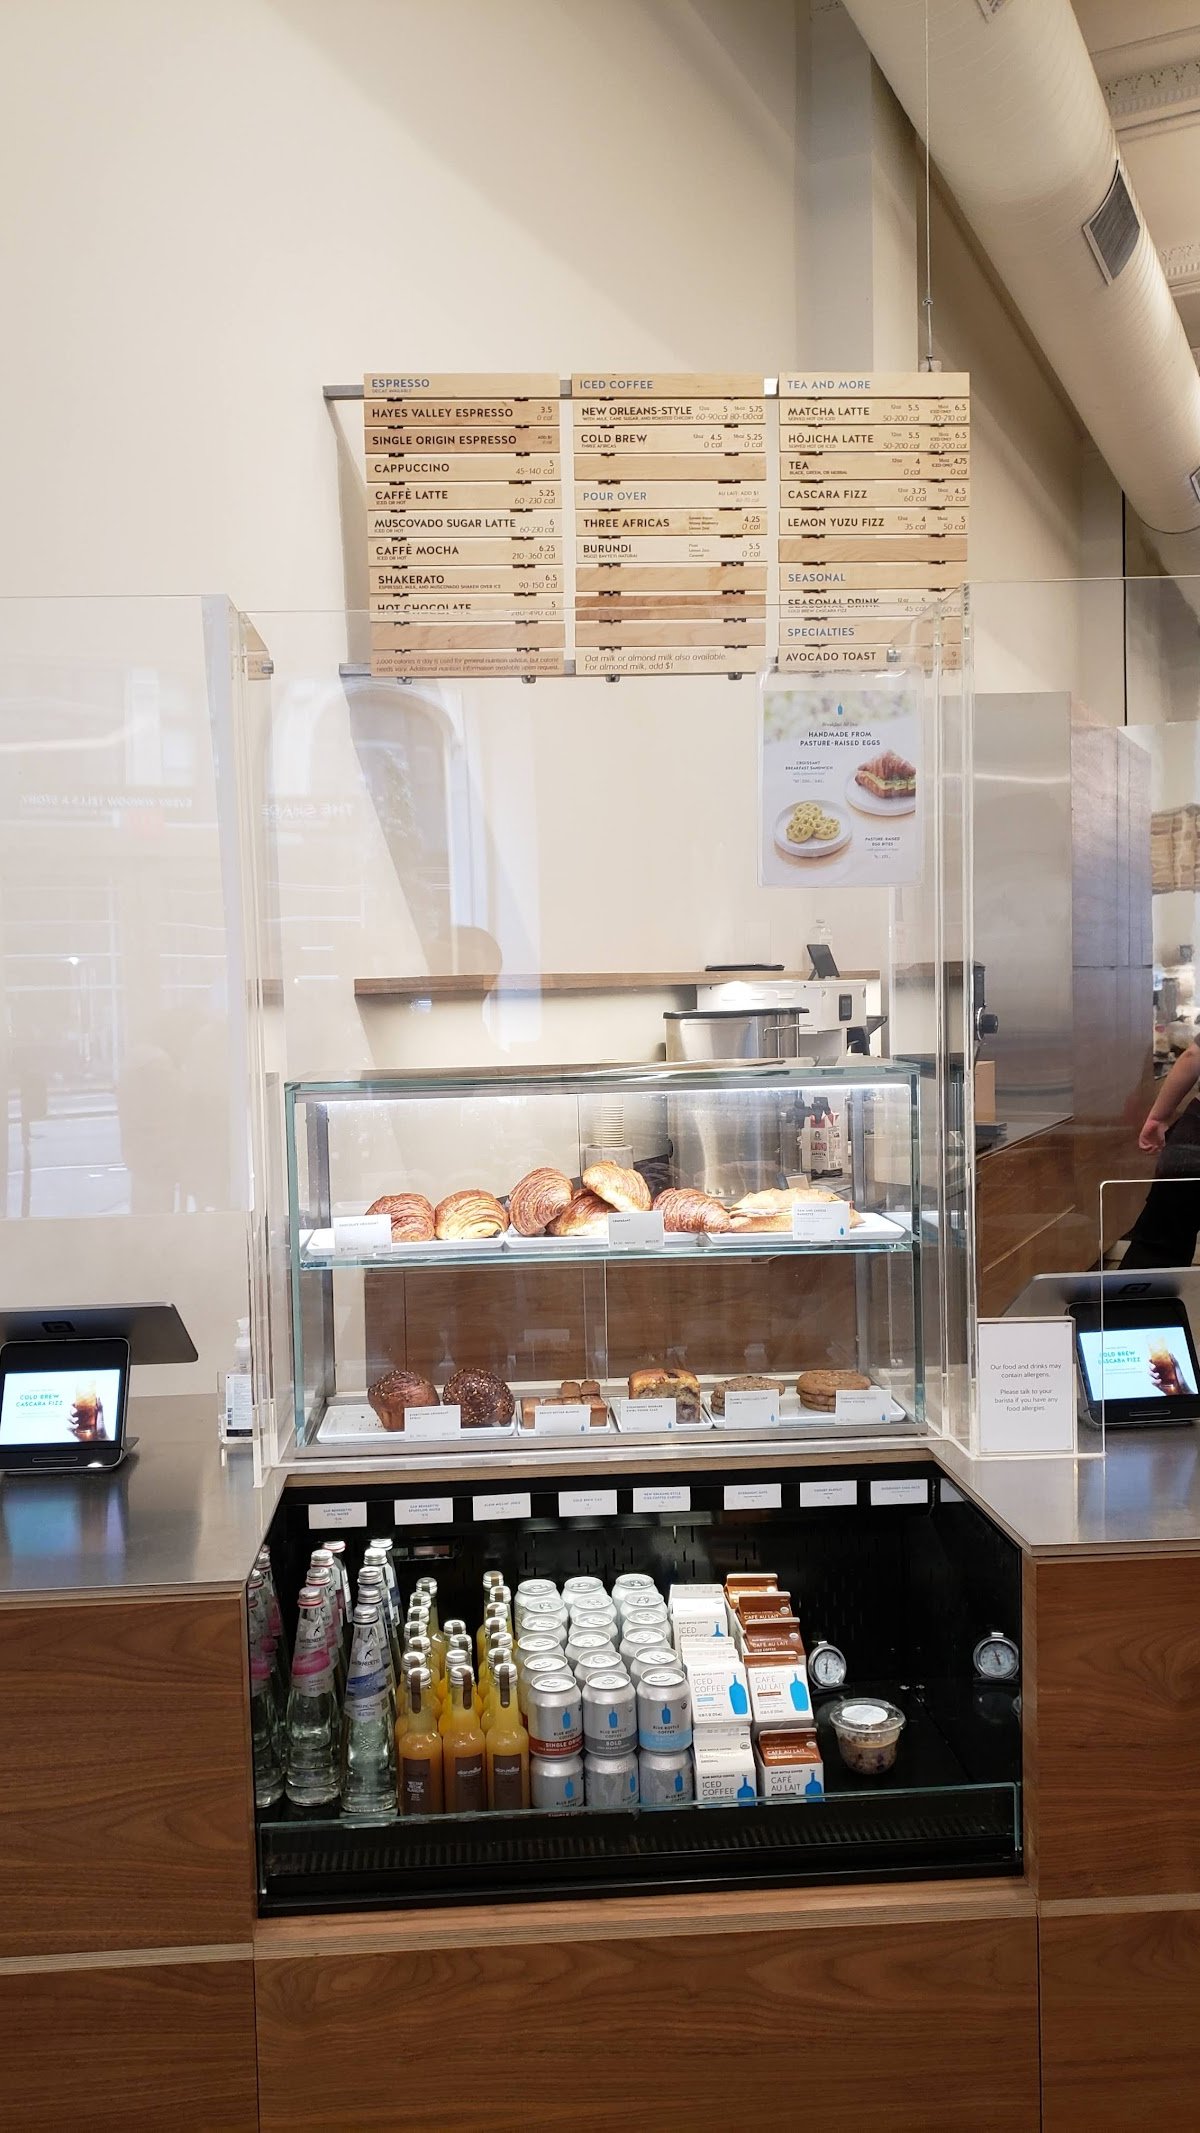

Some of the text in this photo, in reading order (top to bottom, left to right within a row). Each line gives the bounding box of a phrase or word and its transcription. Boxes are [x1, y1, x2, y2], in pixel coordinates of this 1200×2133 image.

[371, 378, 430, 388] ESPRESSO
[580, 380, 653, 389] ICED COFFEE
[787, 380, 871, 389] TEA AND MORE
[372, 408, 513, 418] HAYES VALLEY ESPRESSO
[581, 406, 692, 416] NEW ORLEANS-STYLE
[787, 407, 870, 416] MATCHA LATTE
[372, 435, 517, 445] SINGLE ORIGIN ESPRESSO
[581, 434, 648, 443] COLD BREW
[842, 434, 874, 443] LATTE
[883, 442, 908, 450] 50-200
[909, 442, 920, 450] cal
[929, 442, 955, 450] 60-200
[374, 463, 450, 473] CAPPUCCINO
[789, 461, 809, 470] TEA
[515, 467, 555, 475] 45-140 cal
[375, 488, 448, 500] CAFFÈ LATTE
[538, 489, 555, 497] 5.25
[583, 492, 647, 501] POUR OVER
[787, 490, 868, 499] CASCARA FIZZ
[514, 497, 542, 505] 60-230
[915, 494, 927, 502] cal
[374, 519, 516, 528] MUSCOVADO SUGAR LATTE
[549, 518, 554, 526] 6
[583, 518, 670, 528] THREE AFRICAS
[744, 515, 760, 523] 4.25
[787, 518, 884, 527] LEMON YUZU FIZZ
[519, 526, 543, 534] 60-230
[375, 543, 460, 555] CAFFÈ MOCHA
[538, 544, 555, 552] 6.25
[583, 544, 632, 553] BURUNDI
[512, 552, 556, 560] 210-360 cal
[378, 575, 445, 584] SHAKERATO
[788, 573, 846, 582] SEASONAL
[546, 581, 558, 589] cal
[787, 627, 855, 637] SPECIALTIES
[600, 654, 615, 662] milk
[628, 653, 657, 661] almond
[658, 653, 673, 661] milk
[674, 653, 691, 661] also
[785, 652, 876, 662] AVOCADO TOAST
[584, 661, 673, 671] For almond milk, add $1
[1049, 1363, 1062, 1371] may
[1001, 1371, 1023, 1379] contain
[1014, 1396, 1019, 1404] if
[1019, 1397, 1032, 1405] you
[693, 1678, 713, 1686] ICED
[756, 1682, 786, 1691] AU LAIT
[694, 1684, 726, 1693] COFFEE
[545, 1741, 567, 1749] SINGLE
[770, 1774, 792, 1784] CAFÉ
[702, 1780, 722, 1789] ICED
[784, 1783, 801, 1791] LAIT
[702, 1788, 734, 1796] COFFEE
